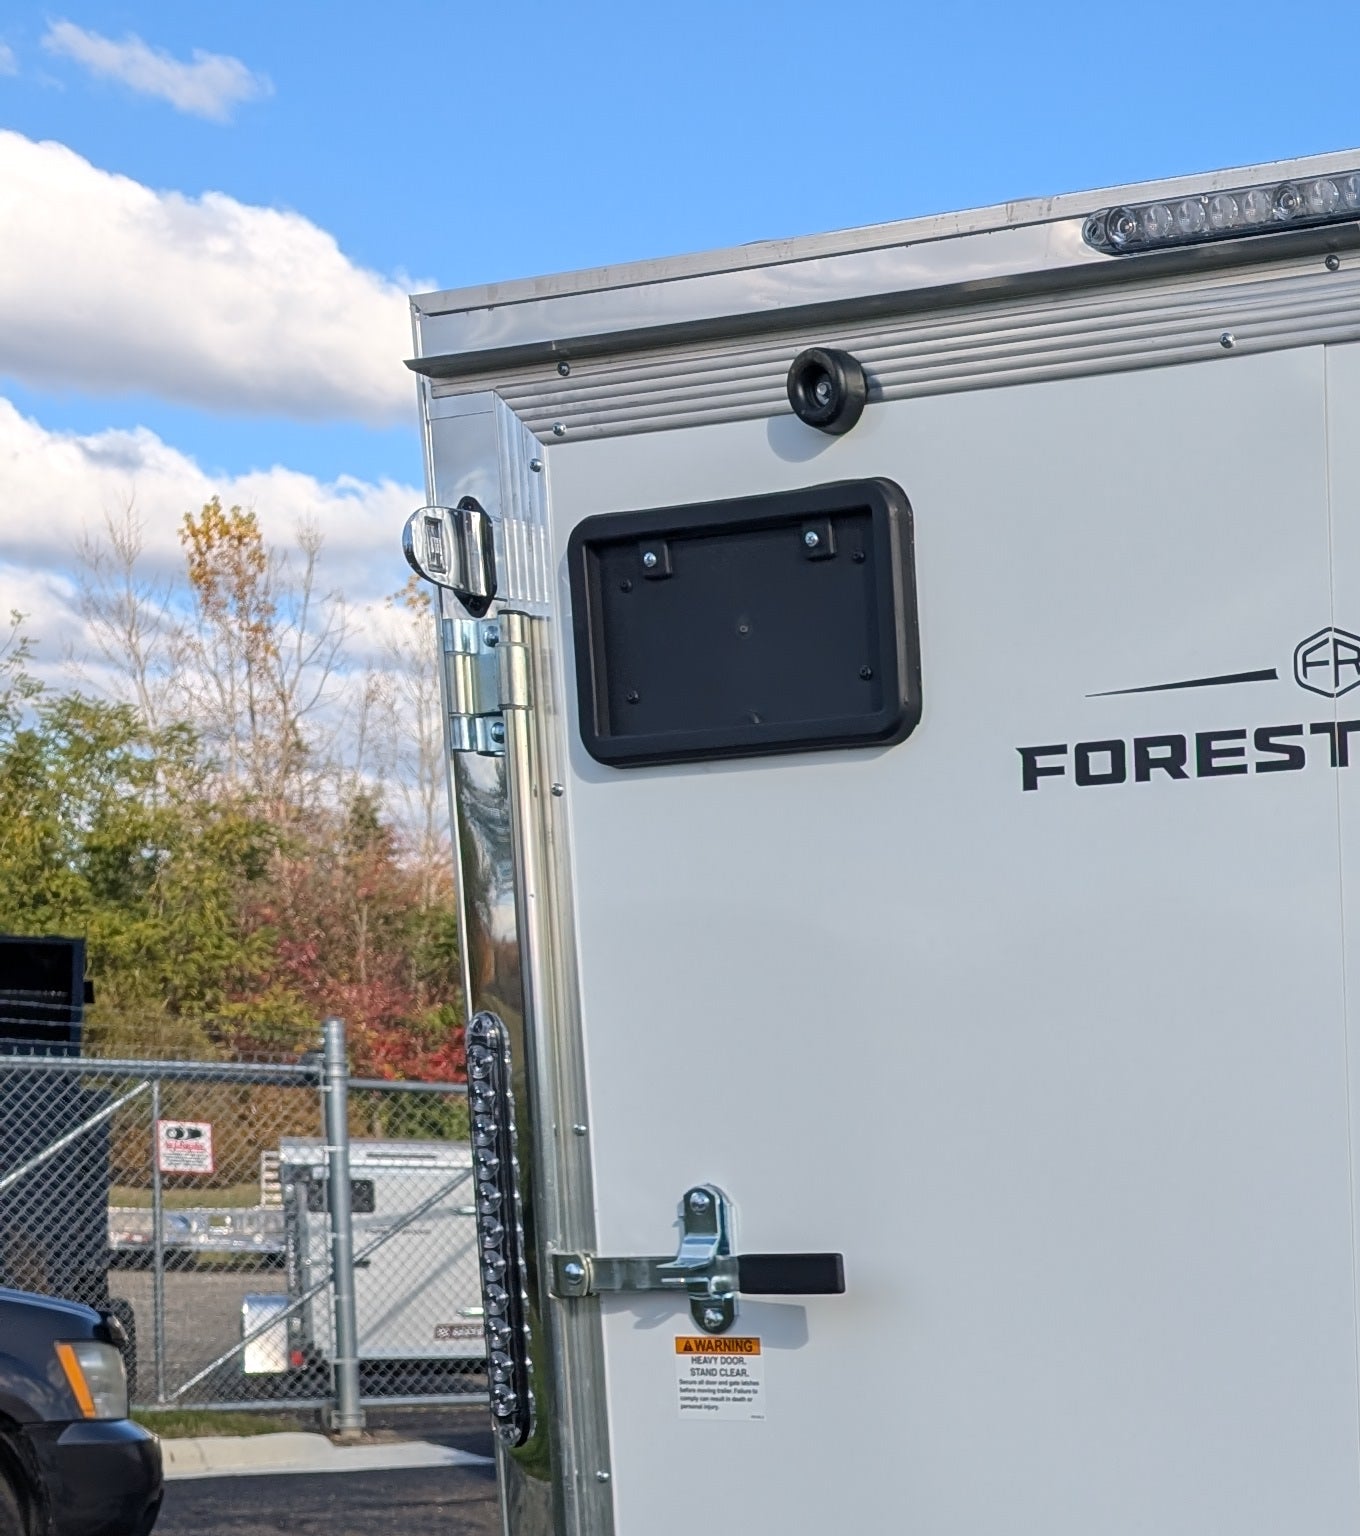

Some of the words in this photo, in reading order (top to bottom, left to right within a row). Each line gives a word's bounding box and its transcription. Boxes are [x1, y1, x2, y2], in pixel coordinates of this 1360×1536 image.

[695, 1340, 753, 1353] WARNING
[691, 1356, 718, 1364] HEAVY
[720, 1357, 748, 1366] DOOR.
[690, 1368, 717, 1377] STAND
[719, 1368, 750, 1377] CLEAR.
